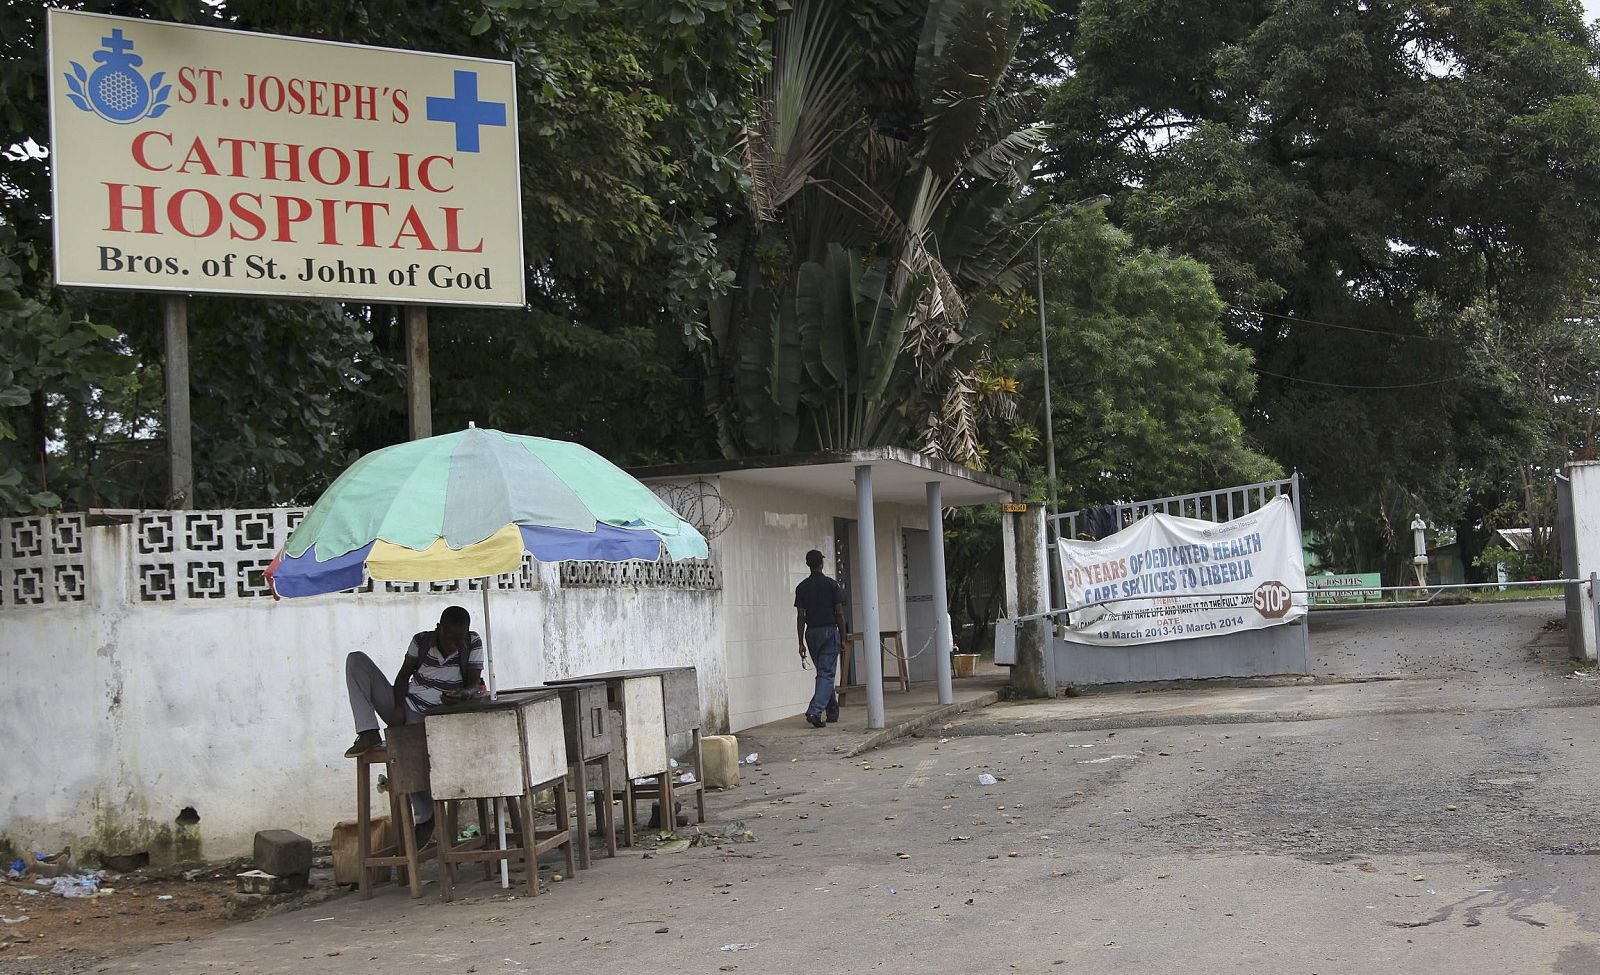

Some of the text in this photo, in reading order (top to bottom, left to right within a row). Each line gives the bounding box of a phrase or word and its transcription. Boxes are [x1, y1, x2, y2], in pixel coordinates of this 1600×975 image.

[177, 66, 409, 124] ST. JOSEPH'S
[130, 130, 454, 193] CATHOLIC
[101, 181, 484, 254] HOSPITAL
[96, 245, 493, 290] Bros. of St. John of God
[1067, 567, 1082, 589] 50
[1084, 558, 1128, 585] YEARS
[1129, 553, 1143, 575] OF
[1145, 543, 1209, 570] DEDICATED
[1212, 532, 1262, 561] HEALTH
[1180, 567, 1197, 589] TO
[1200, 559, 1254, 587] LIBERIA
[1209, 600, 1220, 609] THE
[1255, 584, 1289, 613] STOP
[1097, 631, 1109, 639] 19
[1112, 630, 1142, 639] March
[1186, 621, 1217, 633] March
[1219, 616, 1244, 628] 2014
[1157, 617, 1180, 626] DATE
